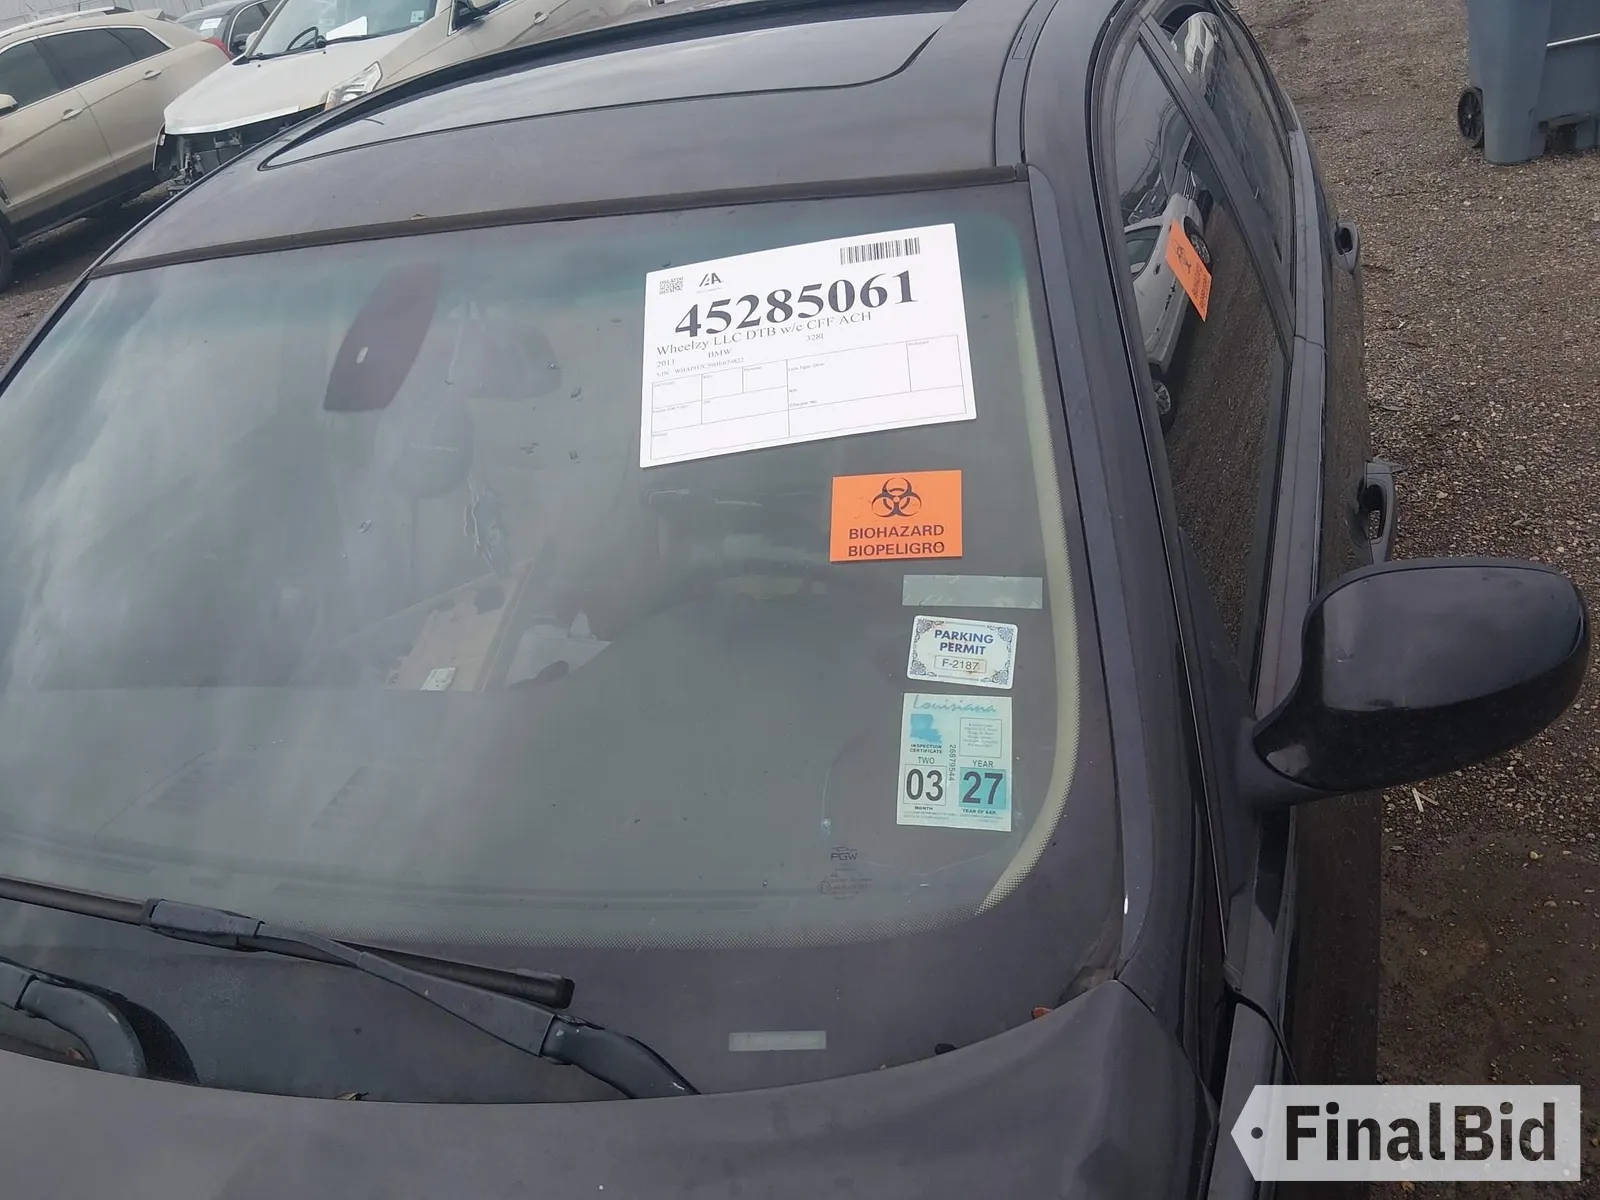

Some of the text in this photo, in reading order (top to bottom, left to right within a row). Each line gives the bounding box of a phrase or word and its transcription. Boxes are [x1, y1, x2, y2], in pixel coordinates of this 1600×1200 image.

[674, 270, 919, 338] 45285061
[656, 340, 710, 356] Wheelzy
[714, 332, 742, 346] LLC
[746, 326, 776, 340] DTB
[806, 317, 834, 330] CFF
[839, 311, 871, 325] ACH
[656, 358, 675, 368] 2011
[708, 348, 732, 358] BMW
[849, 524, 945, 540] BIOHAZARD
[848, 541, 945, 557] BIOPELIGRO
[934, 629, 994, 644] PARKING
[939, 642, 986, 656] PERMIT
[942, 658, 978, 671] F-2187
[913, 694, 997, 712] Louisiana
[918, 756, 935, 764] TWO
[972, 760, 994, 768] YEAR
[906, 768, 943, 801] 03
[962, 771, 1003, 805] 27
